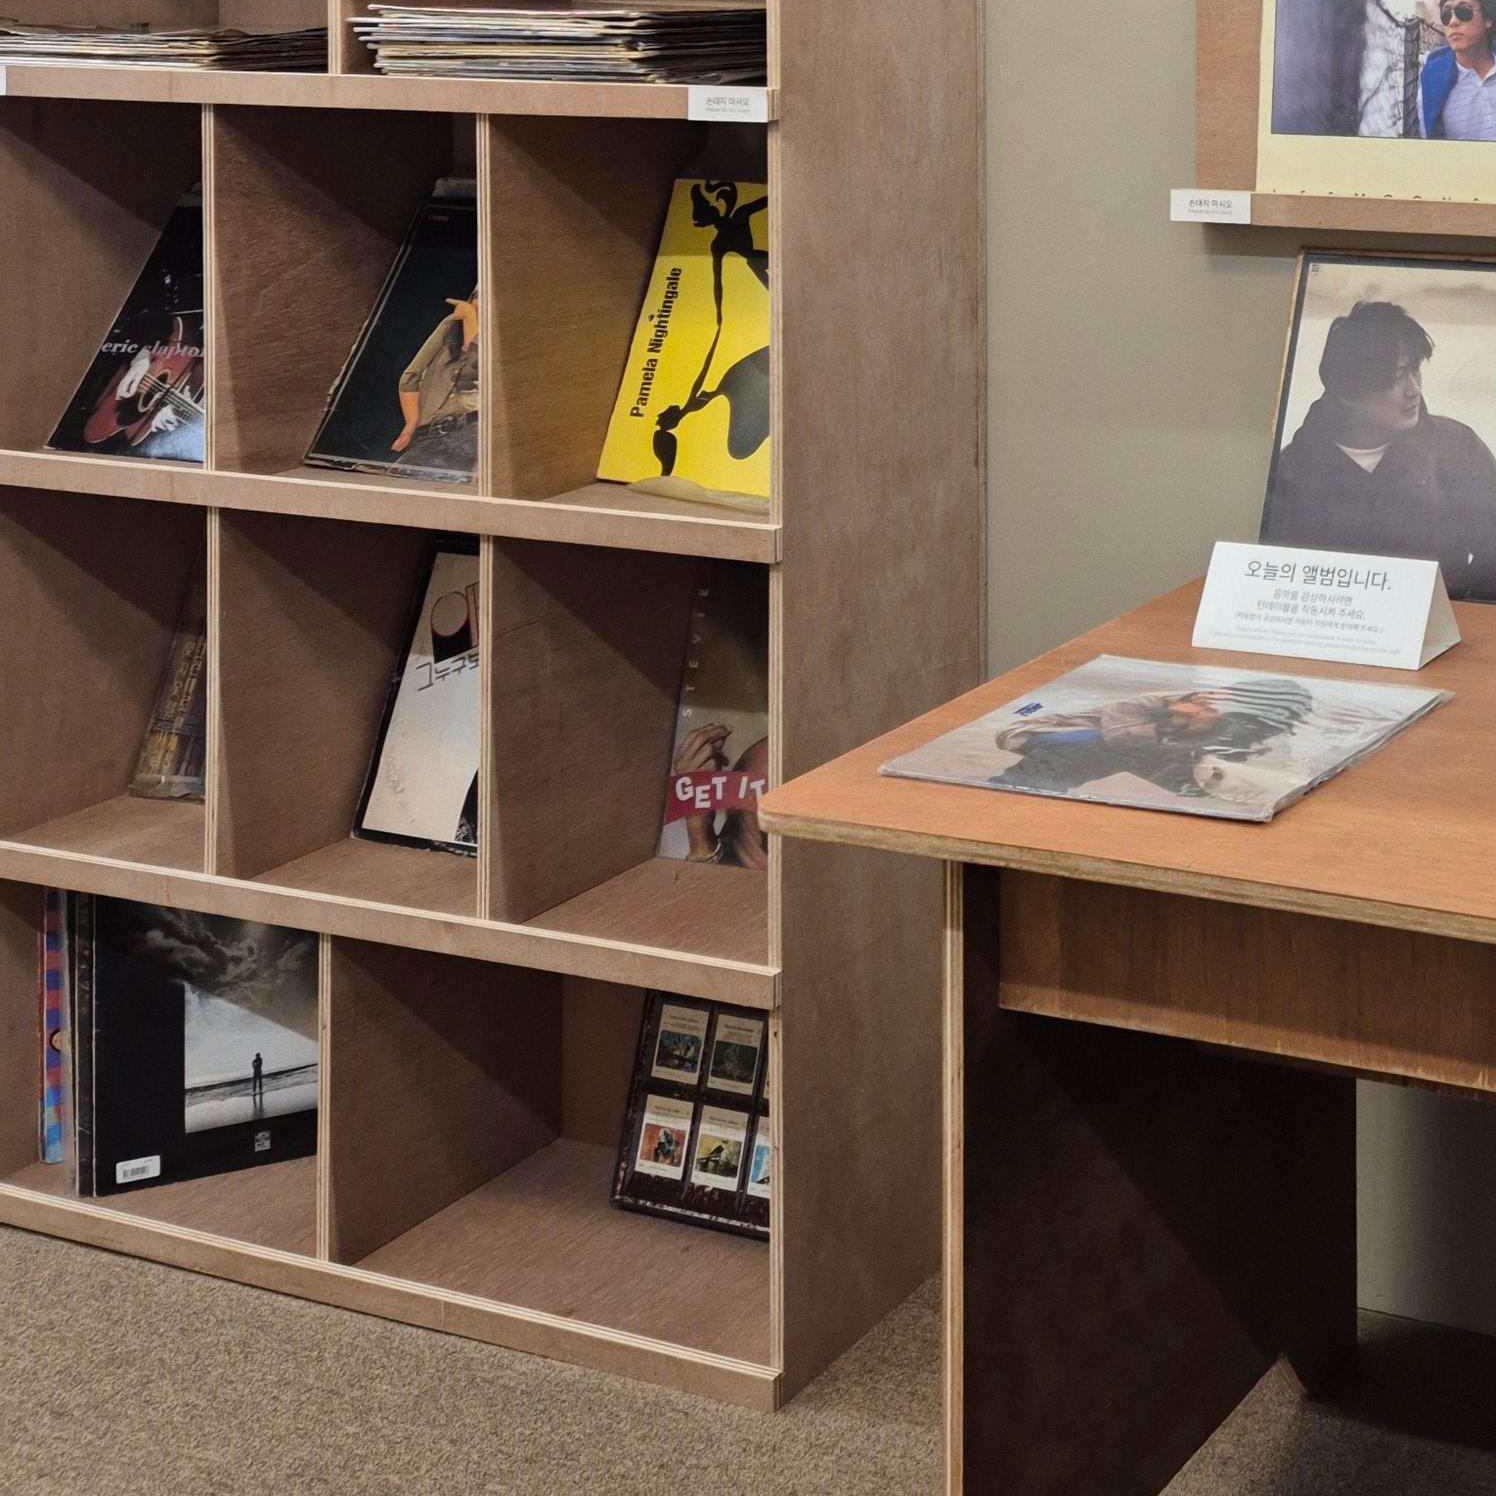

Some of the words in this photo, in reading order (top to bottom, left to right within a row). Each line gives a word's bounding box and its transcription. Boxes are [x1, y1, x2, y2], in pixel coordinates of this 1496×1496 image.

[102, 339, 138, 355] eric
[630, 353, 658, 418] Pamela
[648, 266, 682, 354] Nightingale
[1244, 560, 1296, 583] 오늘의
[1302, 564, 1392, 591] 앨범입니다.
[682, 587, 710, 718] STEVIE
[675, 776, 727, 808] GET
[738, 776, 766, 803] IT
